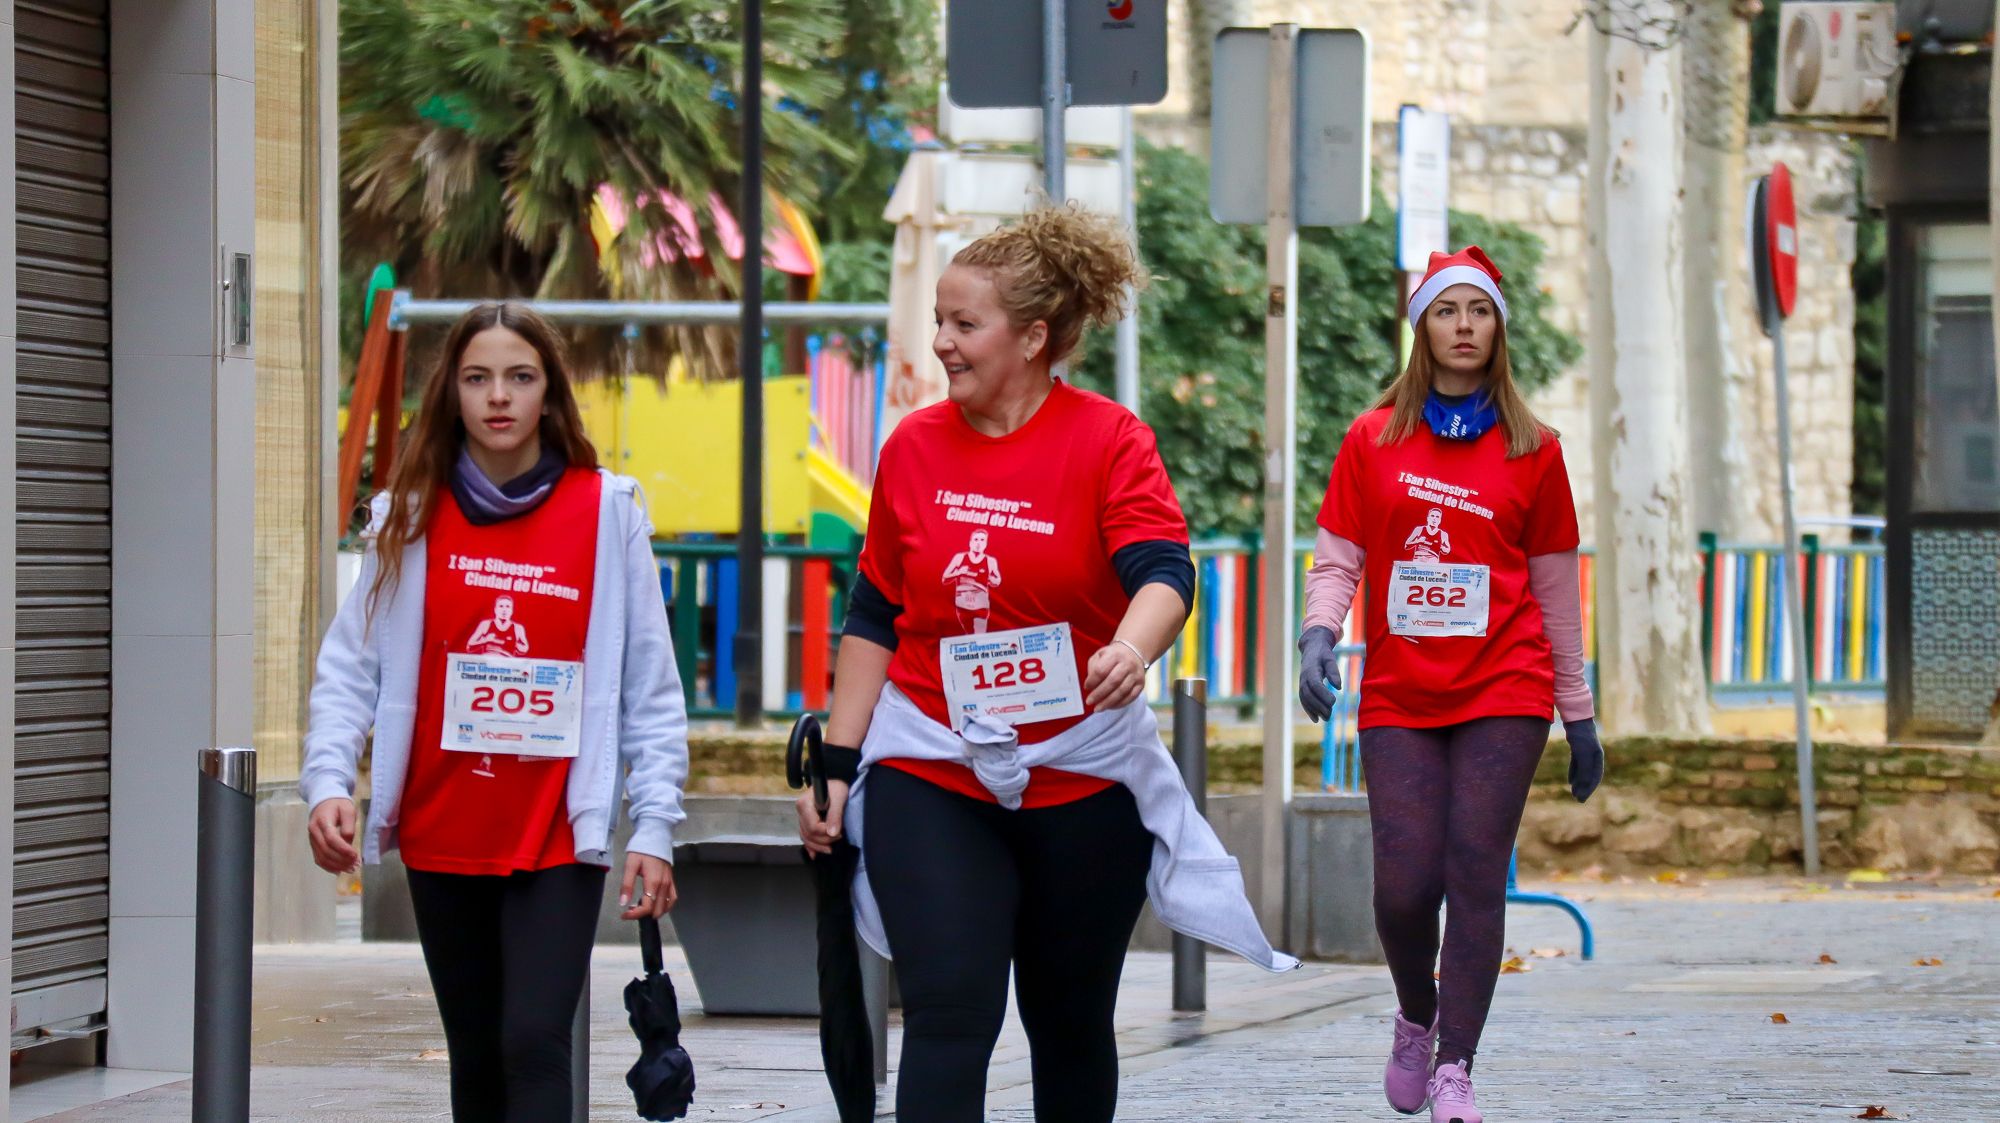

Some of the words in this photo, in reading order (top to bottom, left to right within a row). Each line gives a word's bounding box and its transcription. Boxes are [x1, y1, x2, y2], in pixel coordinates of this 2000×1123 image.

[1398, 472, 1406, 483] I
[1405, 473, 1425, 487] San
[1424, 477, 1469, 498] Silvestre
[935, 489, 944, 504] I
[942, 490, 965, 506] San
[965, 493, 1020, 514] Silvestre
[1408, 486, 1444, 504] Ciudad
[1444, 495, 1458, 508] de
[1458, 499, 1494, 520] Lucena
[946, 506, 990, 525] Ciudad
[989, 512, 1007, 528] de
[1007, 514, 1055, 535] Lucena
[448, 554, 457, 569] I
[458, 555, 483, 571] San
[484, 557, 544, 579] Silvestre
[1410, 568, 1434, 576] Silvestre
[464, 571, 513, 590] Ciudad
[513, 577, 531, 592] de
[531, 579, 579, 601] Lucena
[1407, 585, 1467, 608] 262
[954, 645, 967, 654] San
[969, 642, 1000, 652] Silvestre
[954, 652, 979, 661] Ciudad
[980, 651, 990, 659] de
[991, 649, 1017, 658] Lucena
[461, 672, 487, 681] Ciudad
[488, 673, 498, 681] de
[500, 674, 527, 683] Lucena
[463, 663, 476, 672] San
[479, 664, 512, 674] Silvestre
[972, 658, 1046, 690] 128
[471, 687, 554, 716] 205
[1033, 697, 1067, 707] enerplus
